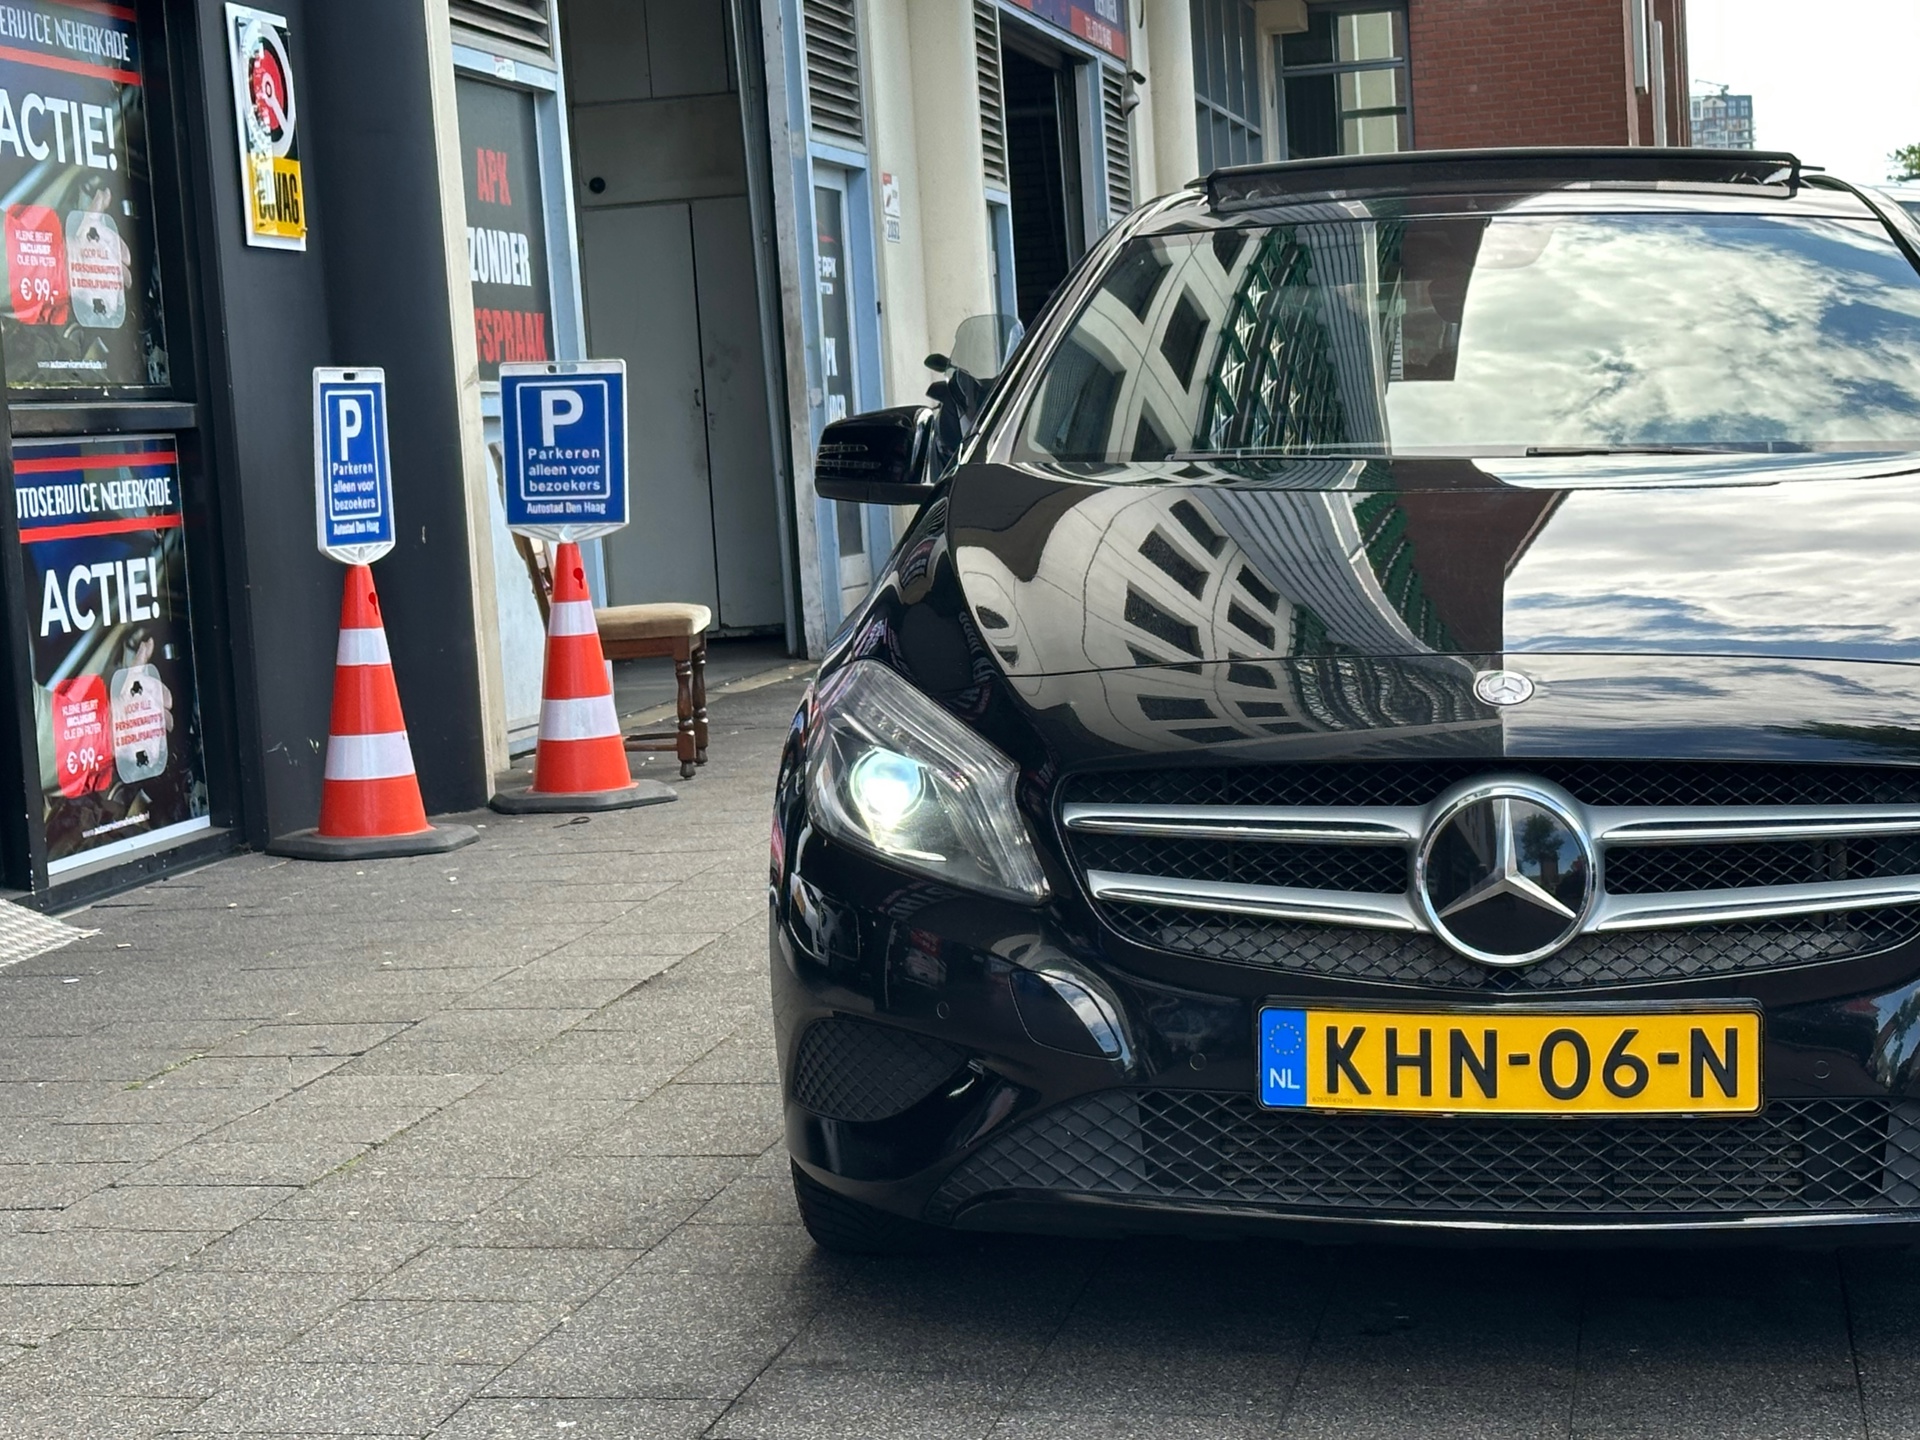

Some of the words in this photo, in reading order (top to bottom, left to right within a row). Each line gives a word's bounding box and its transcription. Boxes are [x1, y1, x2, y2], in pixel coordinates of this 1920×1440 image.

[55, 18, 131, 62] NEHERKADE
[0, 88, 117, 171] ACTIE!
[476, 147, 511, 206] APK
[466, 226, 532, 287] ZONDER
[21, 277, 32, 301] €
[34, 278, 59, 305] 99,-
[338, 398, 362, 461] P
[540, 390, 584, 446] P
[528, 447, 600, 460] Parkeren
[333, 462, 373, 475] Parkeren
[528, 464, 567, 476] alleen
[570, 465, 600, 475] voor
[100, 477, 173, 511] NEHERKADE
[333, 480, 356, 493] alleen
[357, 481, 374, 492] voor
[529, 479, 601, 492] bezoekers
[334, 496, 376, 511] bezoekers
[526, 502, 564, 514] Autostad
[566, 502, 582, 513] Den
[584, 502, 606, 515] Haag
[333, 521, 355, 535] Autostad
[355, 521, 365, 534] Den
[366, 520, 380, 534] Haag
[40, 557, 160, 637] ACTIE!
[67, 751, 78, 775] €
[80, 747, 104, 772] 99,-
[1325, 1026, 1738, 1100] KHN-06-N
[1269, 1067, 1300, 1090] NL
